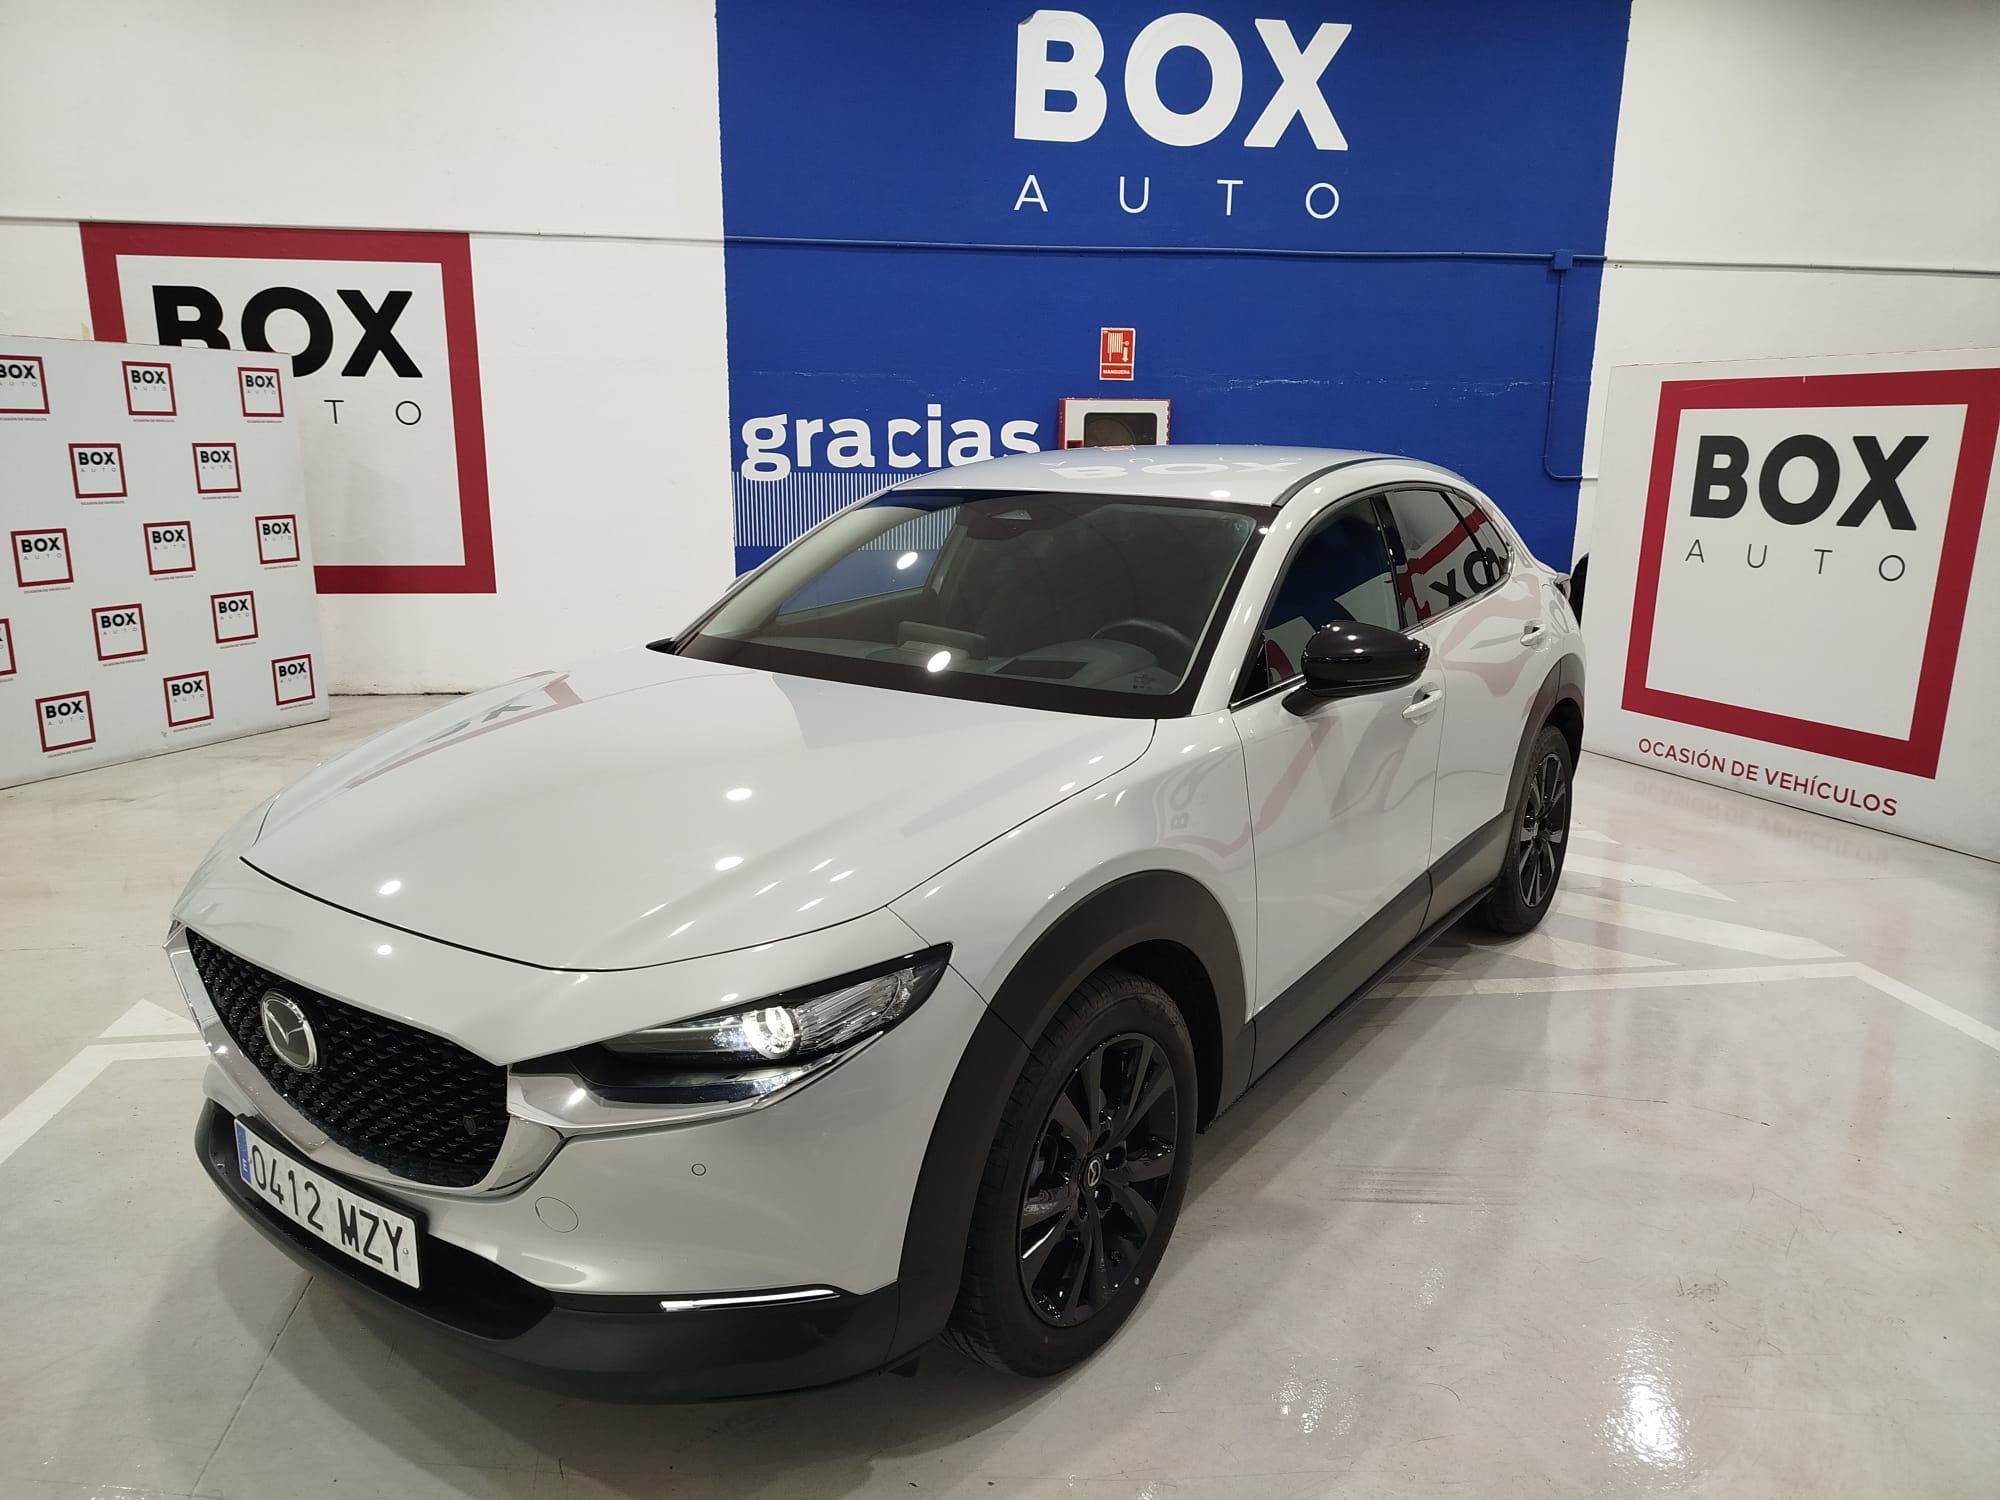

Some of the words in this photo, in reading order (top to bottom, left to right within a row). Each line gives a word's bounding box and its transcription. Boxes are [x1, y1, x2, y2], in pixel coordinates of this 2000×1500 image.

[1014, 9, 1352, 151] BOX
[1013, 174, 1340, 219] AUTO
[152, 285, 423, 378] BOX
[130, 369, 167, 385] BOX
[244, 374, 275, 388] BOX
[323, 399, 422, 425] TO
[741, 403, 1041, 482] gracias
[78, 451, 116, 466] BOX
[200, 450, 232, 464] BOX
[1689, 434, 1929, 531] BOX
[151, 528, 186, 544] BOX
[262, 521, 292, 536] BOX
[21, 537, 61, 553] BOX
[1685, 539, 1906, 582] AUTO
[217, 598, 249, 614] BOX
[100, 611, 137, 629] BOX
[278, 661, 307, 678] BOX
[171, 679, 204, 697] BOX
[45, 699, 84, 719] BOX
[1638, 738, 1726, 774] OCASIÓN
[1731, 760, 1759, 782] DE
[1765, 768, 1898, 817] VEHÍCULOS
[252, 1145, 324, 1232] 0412
[338, 1198, 403, 1272] MZY
